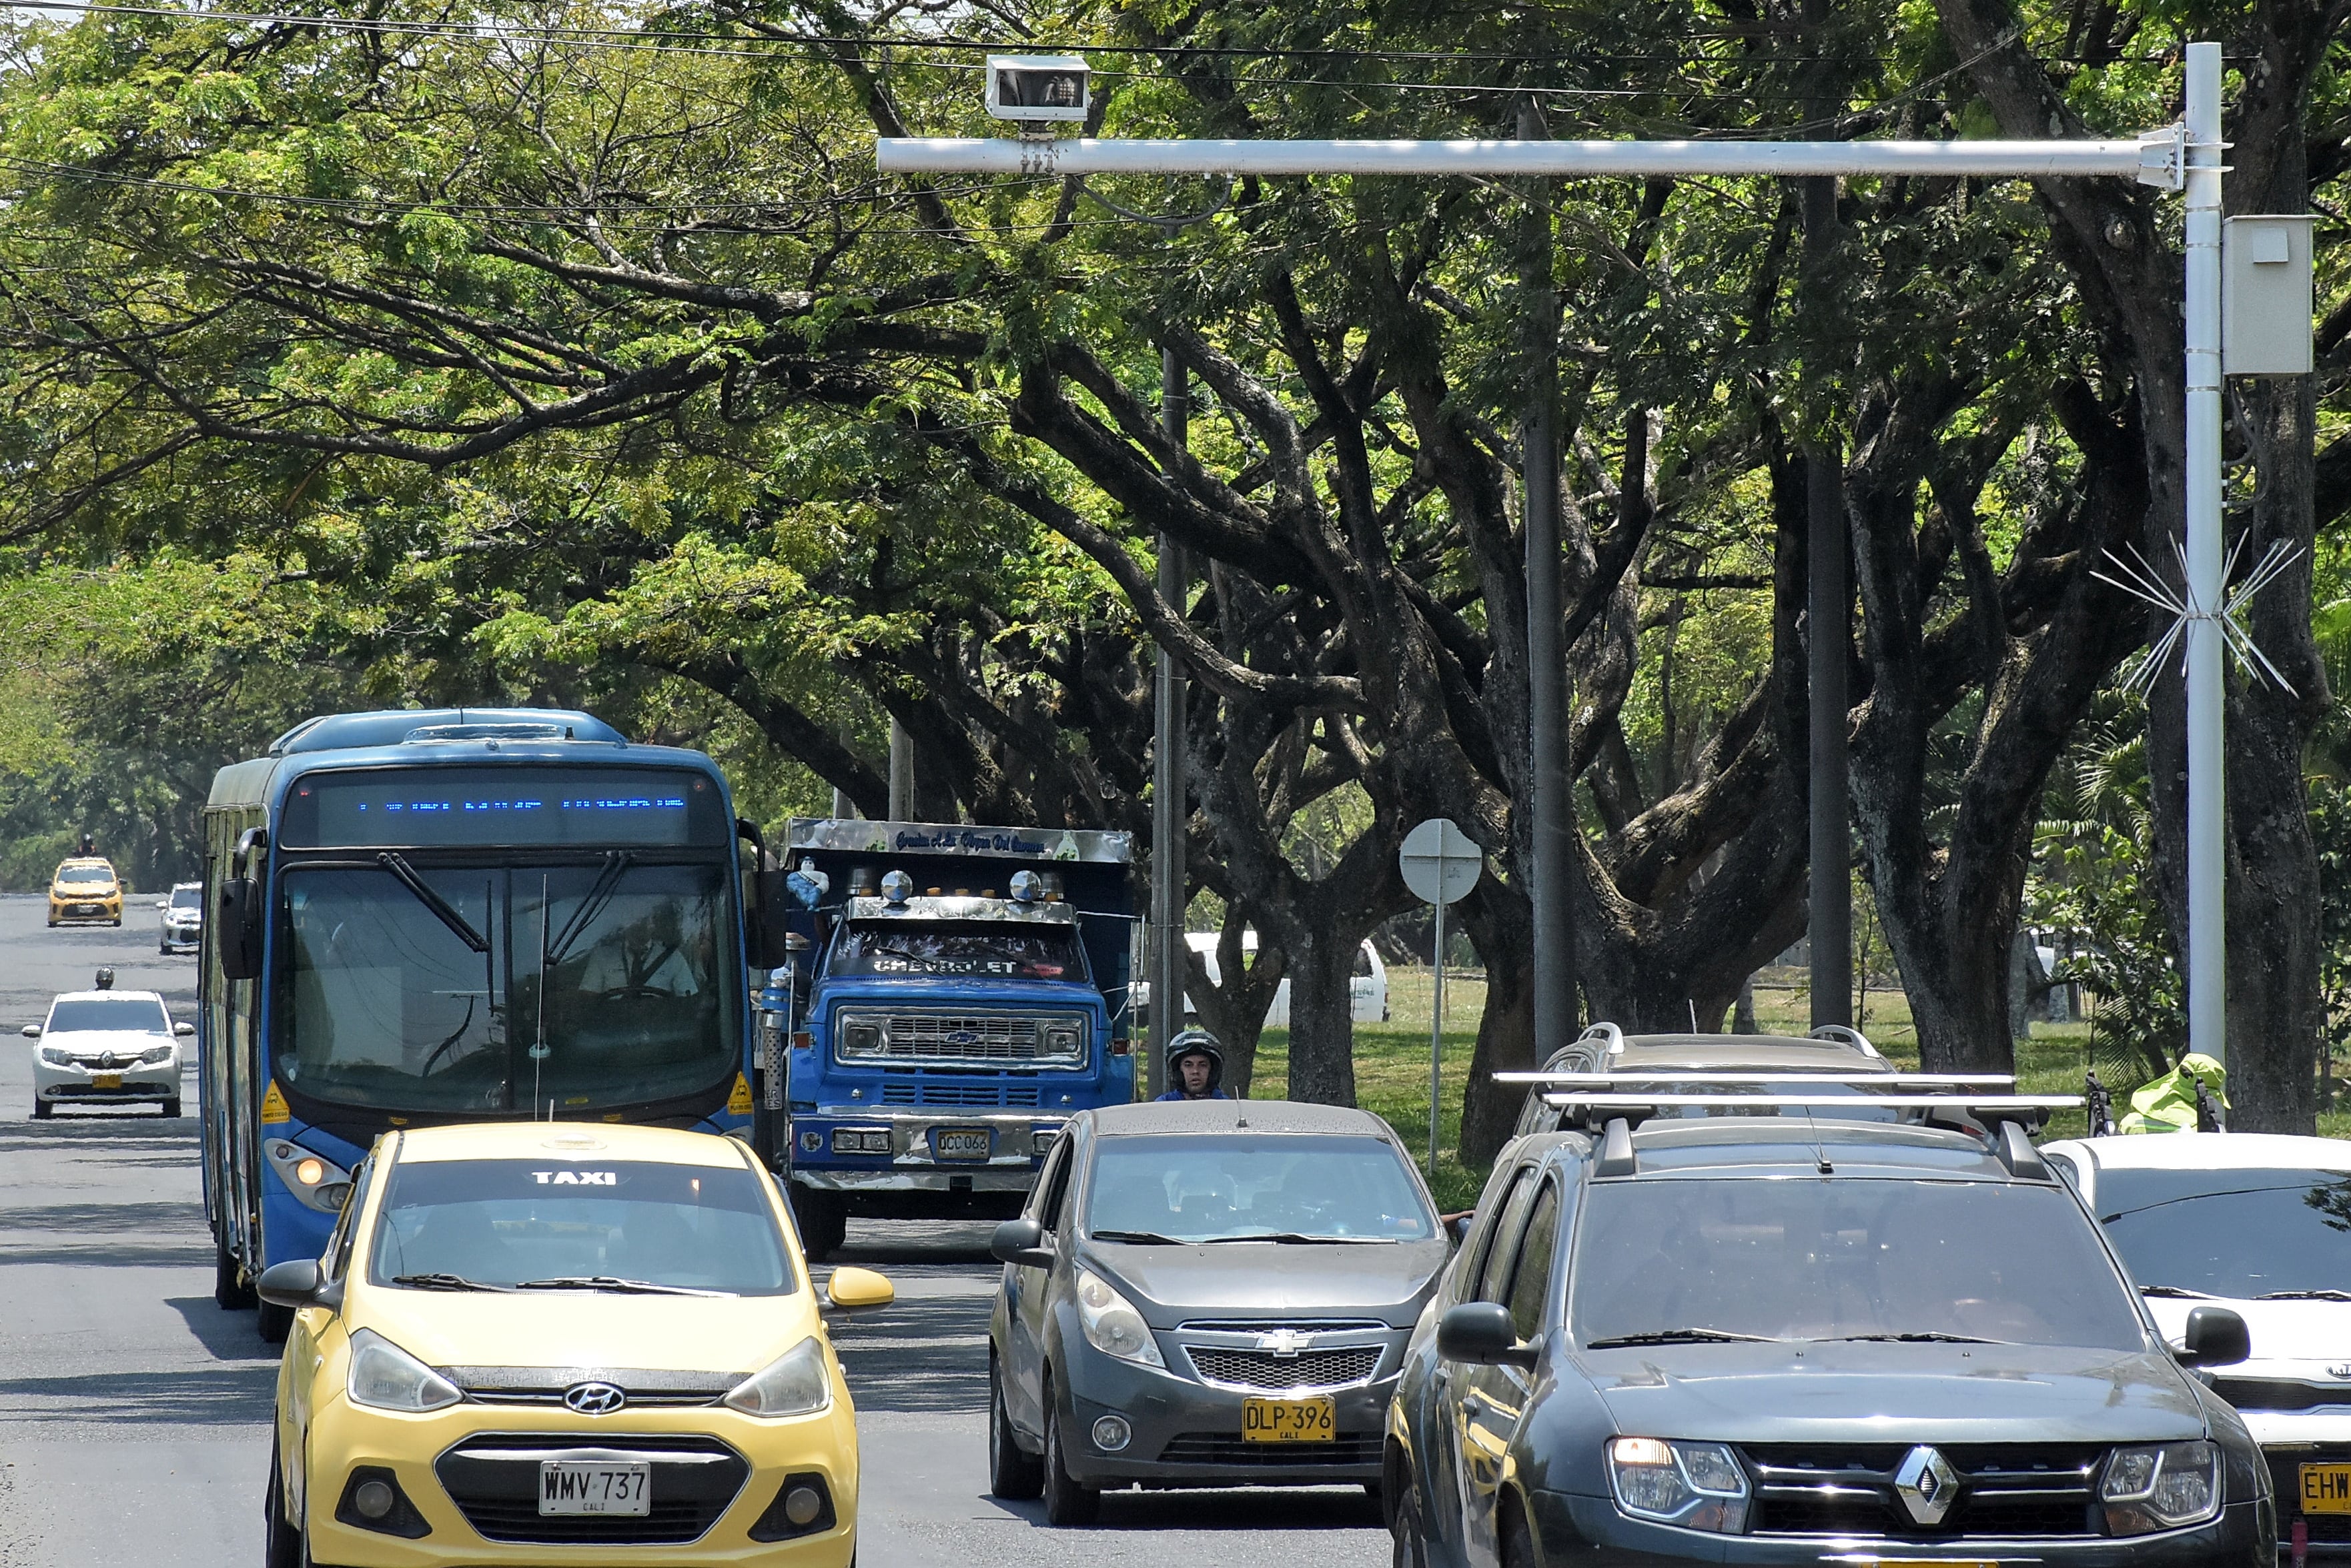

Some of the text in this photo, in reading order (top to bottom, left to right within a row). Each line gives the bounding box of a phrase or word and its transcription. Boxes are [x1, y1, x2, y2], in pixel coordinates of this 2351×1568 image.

[532, 1171, 616, 1185] TAXI
[2304, 1473, 2348, 1499] EHW
[583, 1503, 605, 1511] CALI
